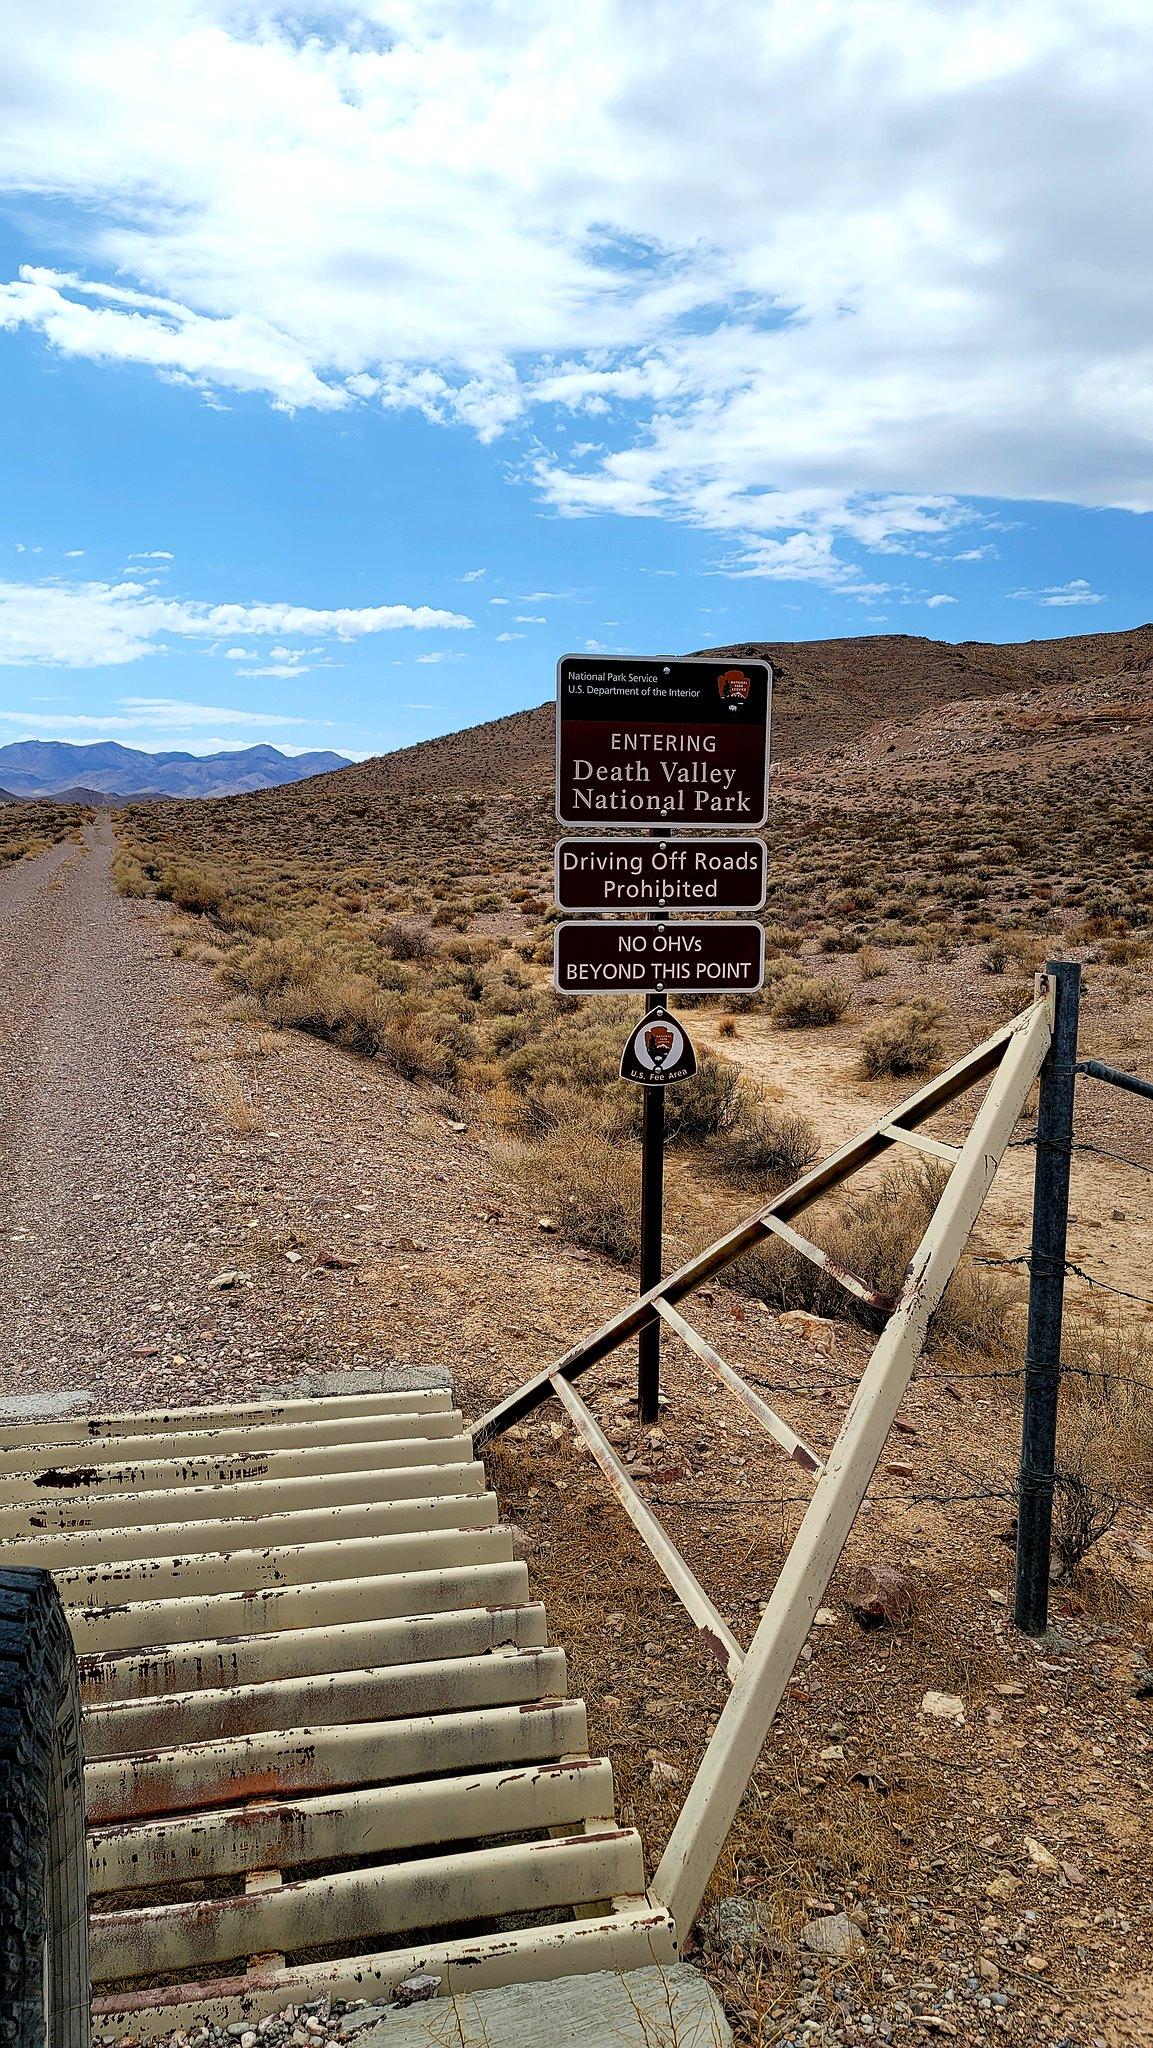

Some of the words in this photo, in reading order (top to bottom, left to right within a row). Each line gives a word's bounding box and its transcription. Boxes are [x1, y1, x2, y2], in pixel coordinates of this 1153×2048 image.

[569, 672, 605, 681] National
[608, 673, 626, 681] Park
[629, 674, 657, 682] Service
[569, 685, 584, 693] U.S.
[587, 686, 639, 696] Department
[641, 687, 650, 695] of
[653, 688, 667, 696] the
[669, 689, 700, 697] Interior
[612, 734, 715, 752] ENTERING
[573, 760, 650, 781] Death
[660, 762, 736, 789] Valley
[572, 789, 684, 811] National
[694, 791, 750, 811] Park
[564, 852, 642, 875] Driving
[652, 851, 686, 870] Off
[696, 852, 757, 870] Roads
[605, 879, 717, 898] Prohibited
[619, 936, 646, 951] NO
[653, 936, 701, 951] OHVs
[567, 964, 645, 979] BEYOND
[651, 963, 690, 979] THIS
[697, 963, 751, 978] POINT
[631, 1070, 645, 1079] U.S.
[668, 1069, 688, 1079] Area
